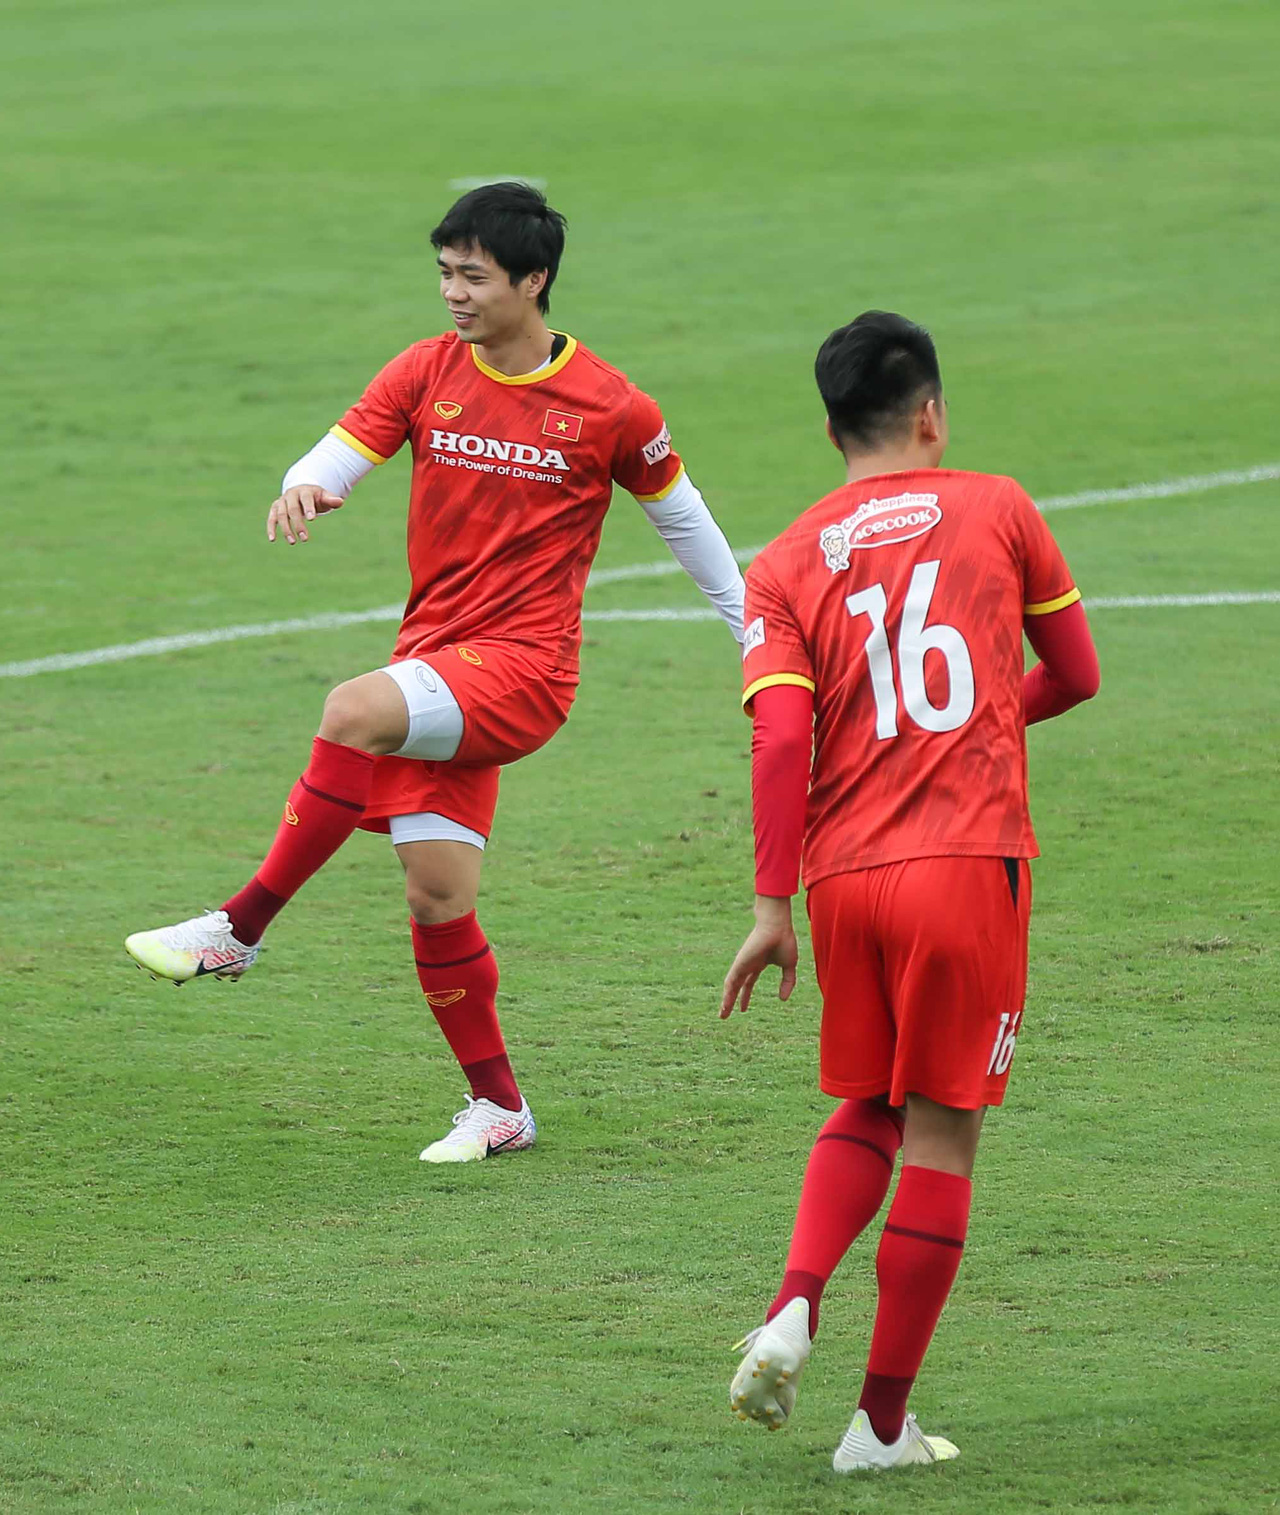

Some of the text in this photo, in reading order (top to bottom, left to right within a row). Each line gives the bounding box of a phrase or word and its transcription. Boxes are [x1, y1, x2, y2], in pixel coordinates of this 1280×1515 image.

[429, 429, 570, 470] HONDA
[433, 453, 563, 484] The Power of Dreams
[843, 495, 935, 531] Cook happiness
[846, 559, 976, 740] 16
[986, 1010, 1020, 1076] 16
